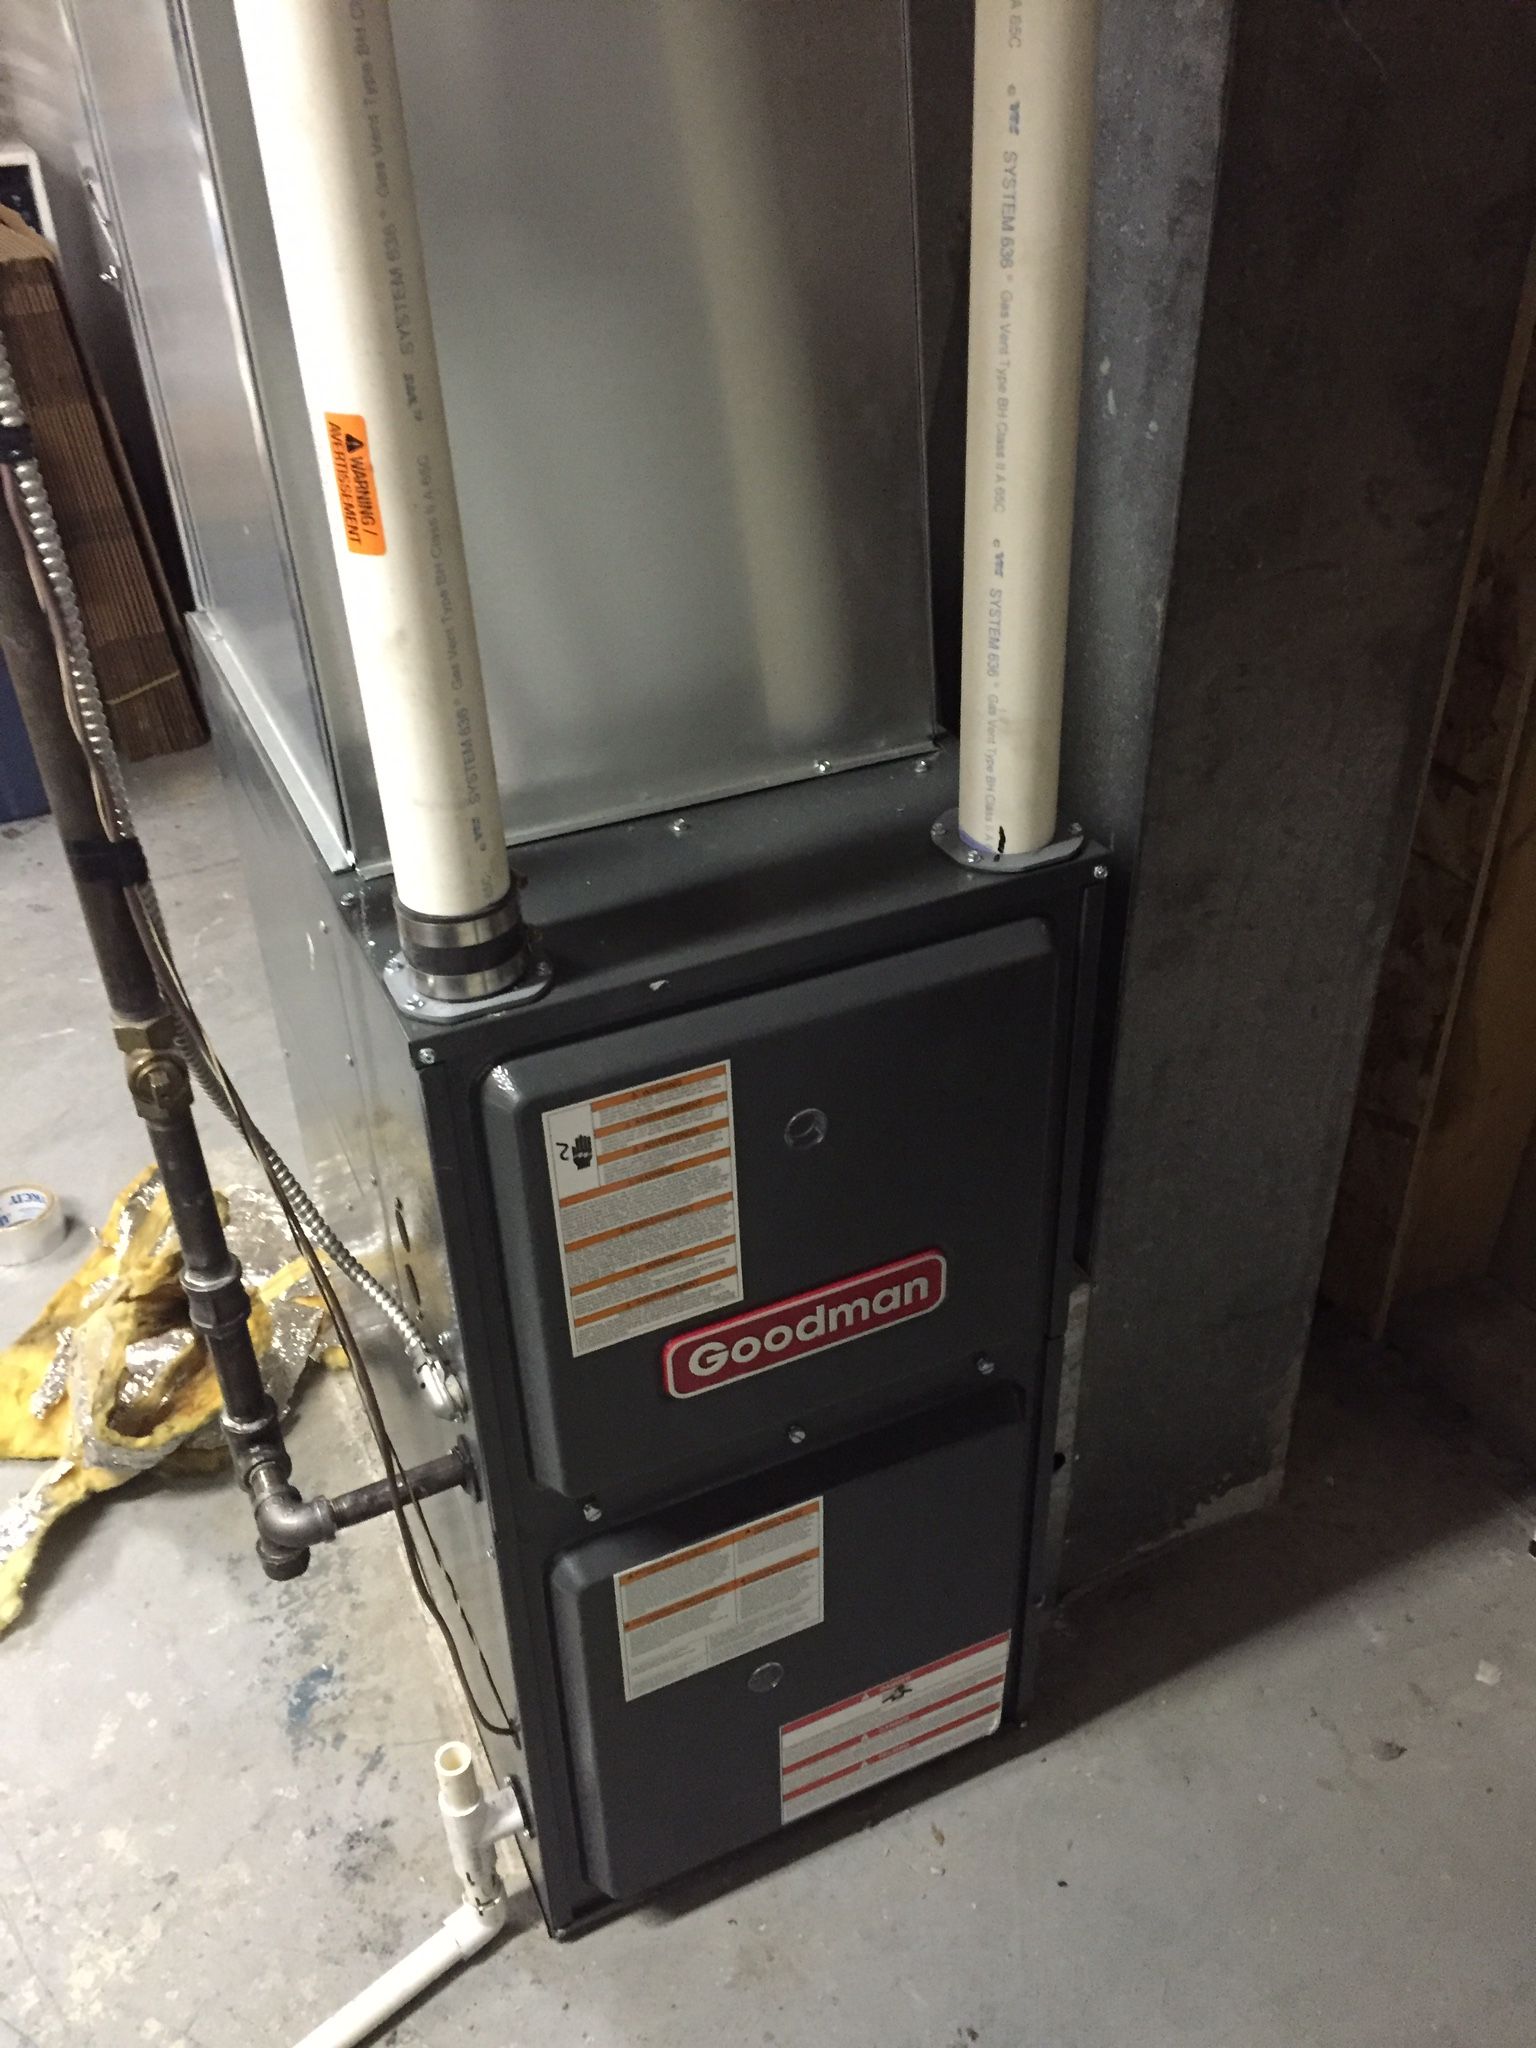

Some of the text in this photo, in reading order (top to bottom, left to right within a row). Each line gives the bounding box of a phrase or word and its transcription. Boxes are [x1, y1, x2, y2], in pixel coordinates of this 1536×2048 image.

[1000, 150, 1018, 232] SYSTEM
[382, 223, 400, 262] 636
[999, 235, 1016, 270] 636
[388, 268, 414, 355] SYSTEM
[999, 289, 1013, 319] Gas
[999, 323, 1012, 355] Vent
[996, 360, 1010, 393] Type
[997, 397, 1009, 418] BH
[995, 422, 1008, 458] Class
[328, 421, 362, 545] AVERTISSEMENT
[349, 456, 375, 526] WARNING
[995, 474, 1006, 483] A
[993, 487, 1007, 513] 65C
[988, 588, 1003, 649] SYSTEM
[444, 627, 459, 660] Vent
[986, 653, 1001, 677] 636
[986, 694, 999, 715] Gas
[455, 707, 471, 737] 636
[986, 719, 998, 744] Vent
[460, 739, 481, 805] SYSTEM
[984, 748, 997, 772] Type
[985, 775, 997, 791] BH
[984, 795, 996, 821] Class
[687, 1275, 929, 1378] Goodman
